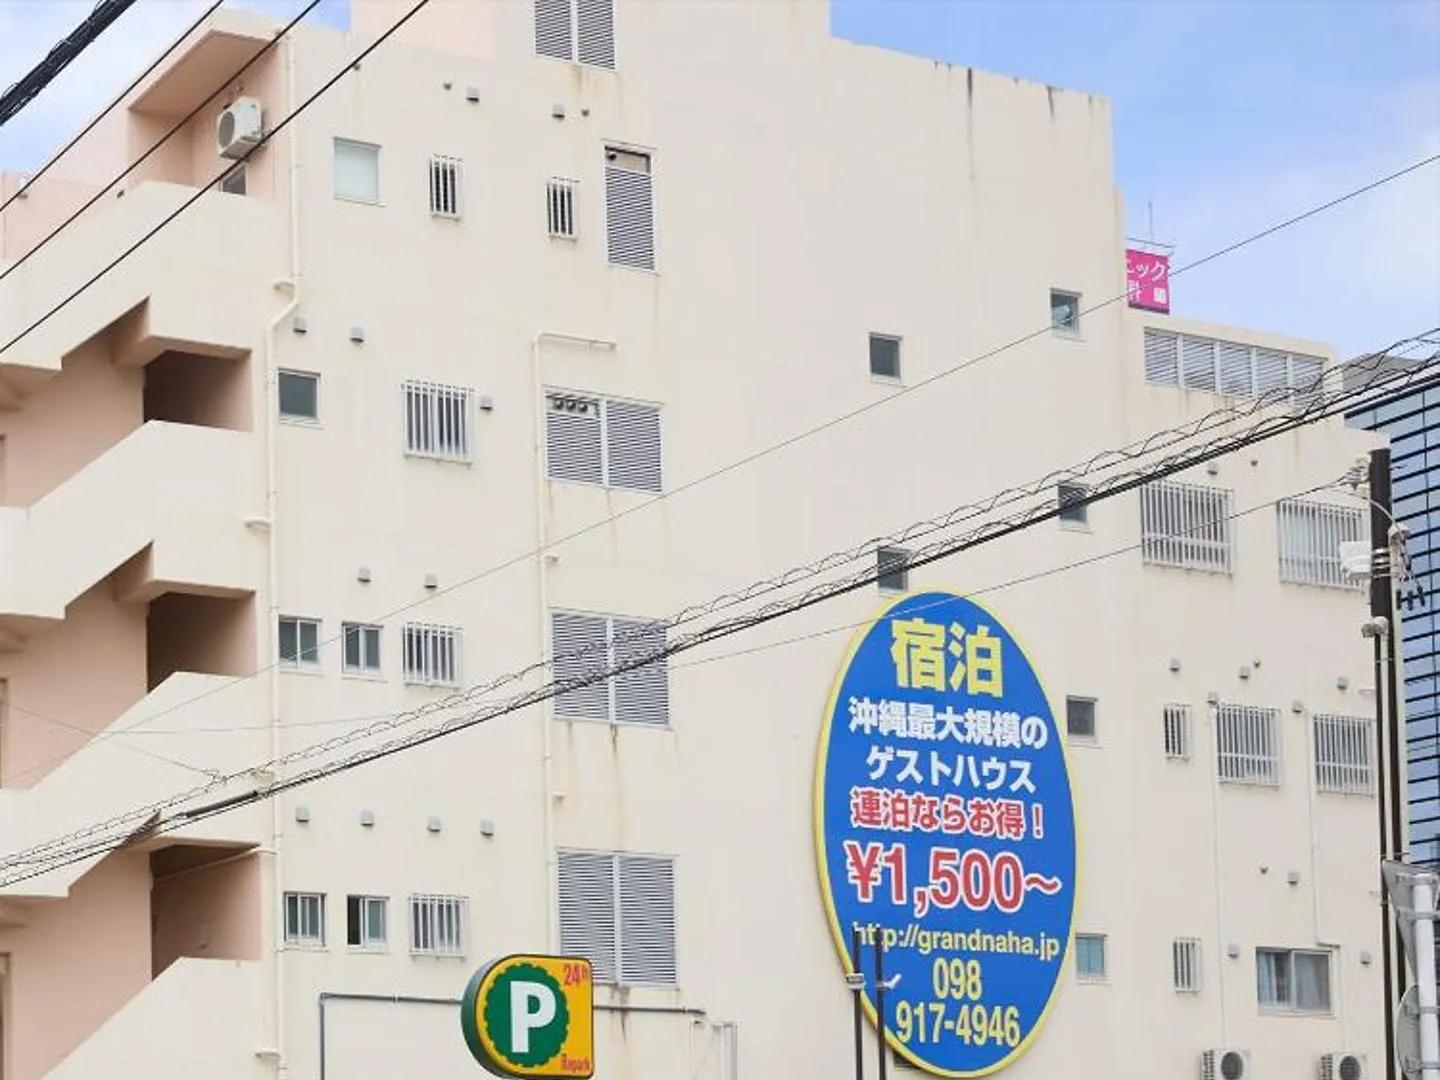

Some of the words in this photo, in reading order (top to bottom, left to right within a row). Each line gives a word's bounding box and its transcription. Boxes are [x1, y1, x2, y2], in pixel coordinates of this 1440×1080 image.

[891, 617, 1004, 699] 宿泊
[848, 697, 1049, 751] 沖縄最大規模の
[866, 746, 1037, 795] ゲストハウス
[852, 921, 1060, 961] htp://grandnaha.jp
[932, 957, 982, 1001] 098
[510, 981, 557, 1053] P
[896, 1000, 1021, 1048] 917-4946
